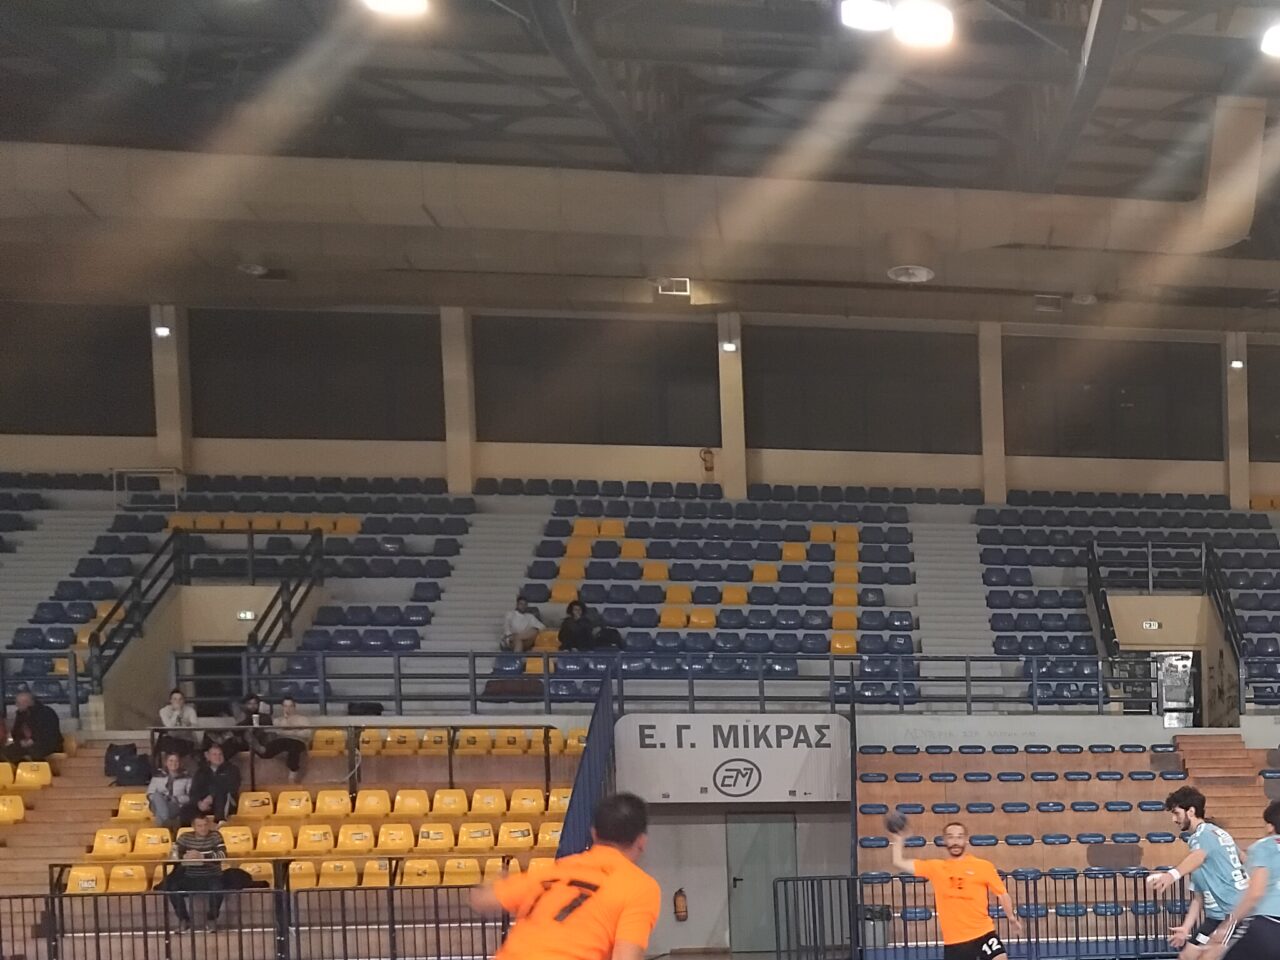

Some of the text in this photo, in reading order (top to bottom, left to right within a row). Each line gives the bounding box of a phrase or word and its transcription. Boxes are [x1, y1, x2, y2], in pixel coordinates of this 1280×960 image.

[639, 724, 666, 749] Ε.
[675, 724, 697, 749] Γ.
[981, 937, 1001, 955] 12
